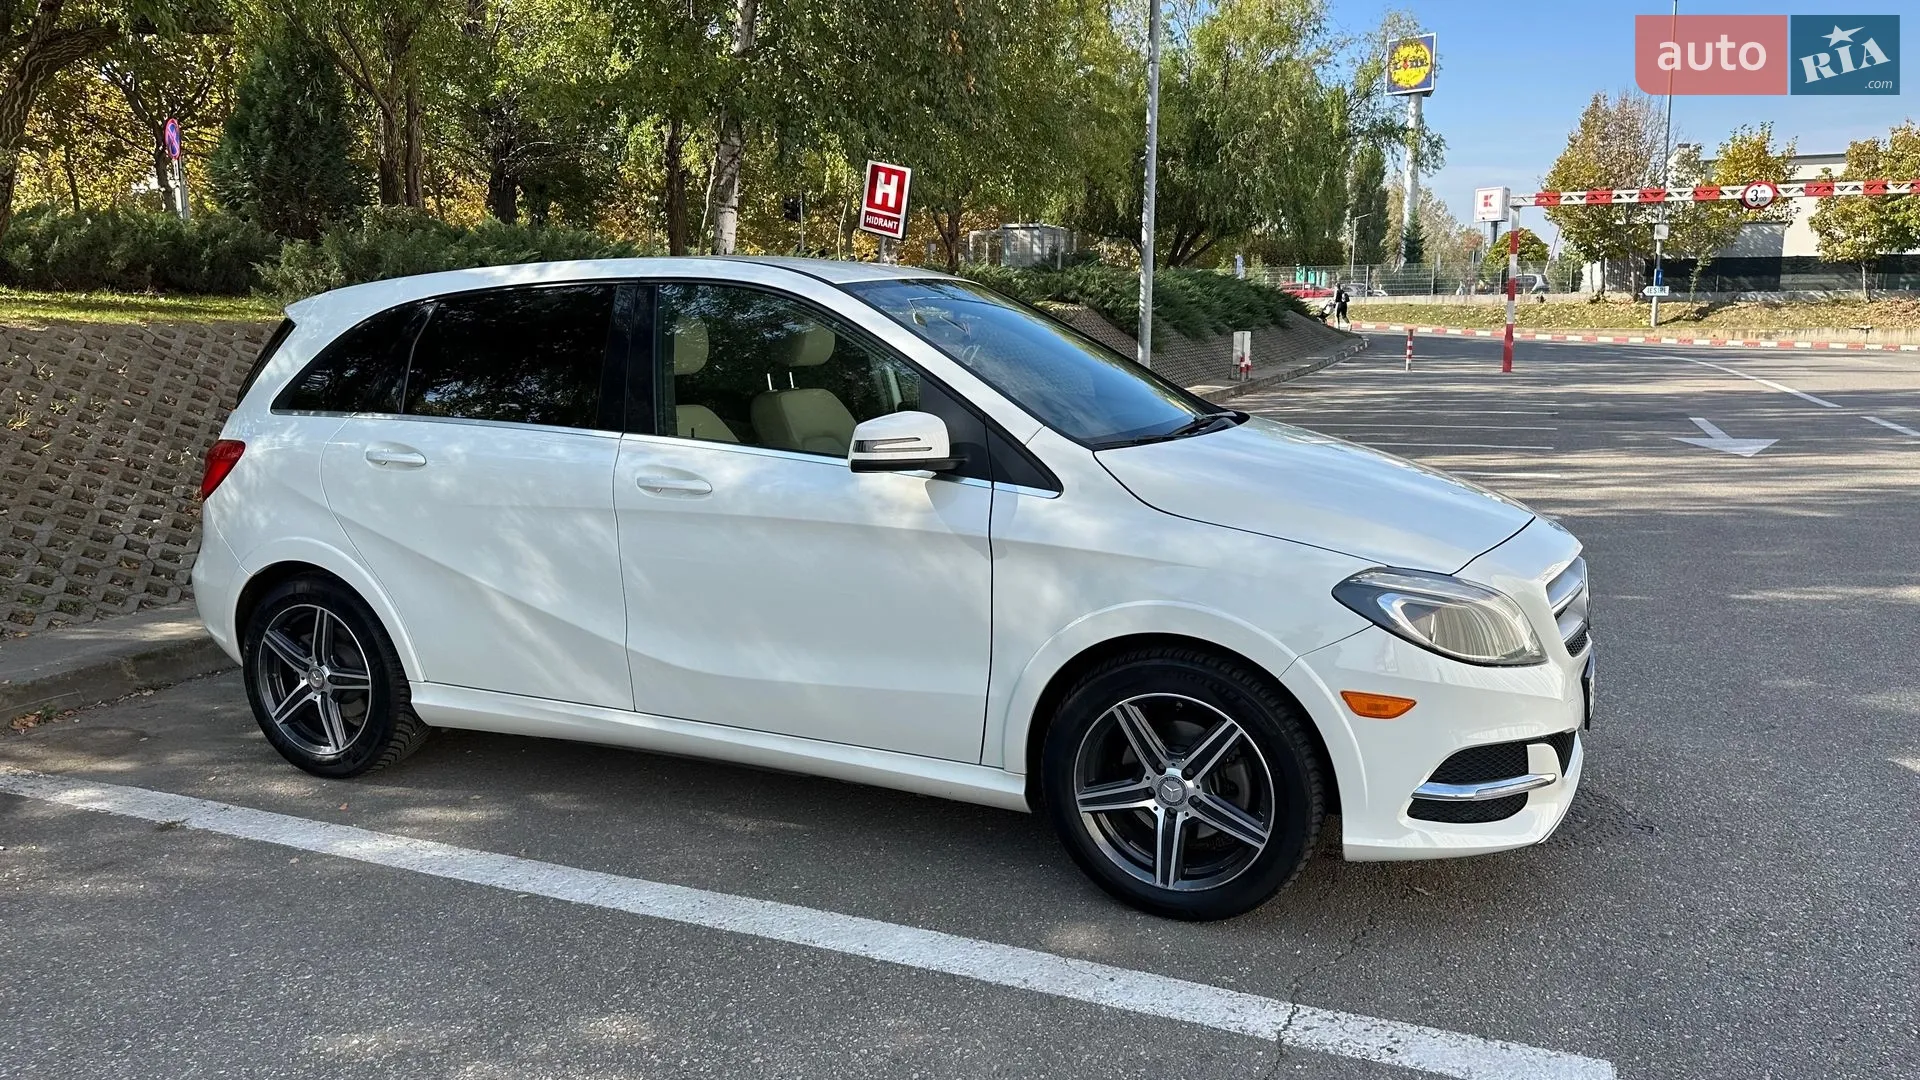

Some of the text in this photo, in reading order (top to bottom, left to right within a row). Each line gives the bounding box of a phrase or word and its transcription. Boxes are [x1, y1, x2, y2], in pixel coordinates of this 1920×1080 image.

[874, 171, 899, 208] H
[1750, 189, 1758, 202] 3
[866, 215, 898, 230] HIDRANT
